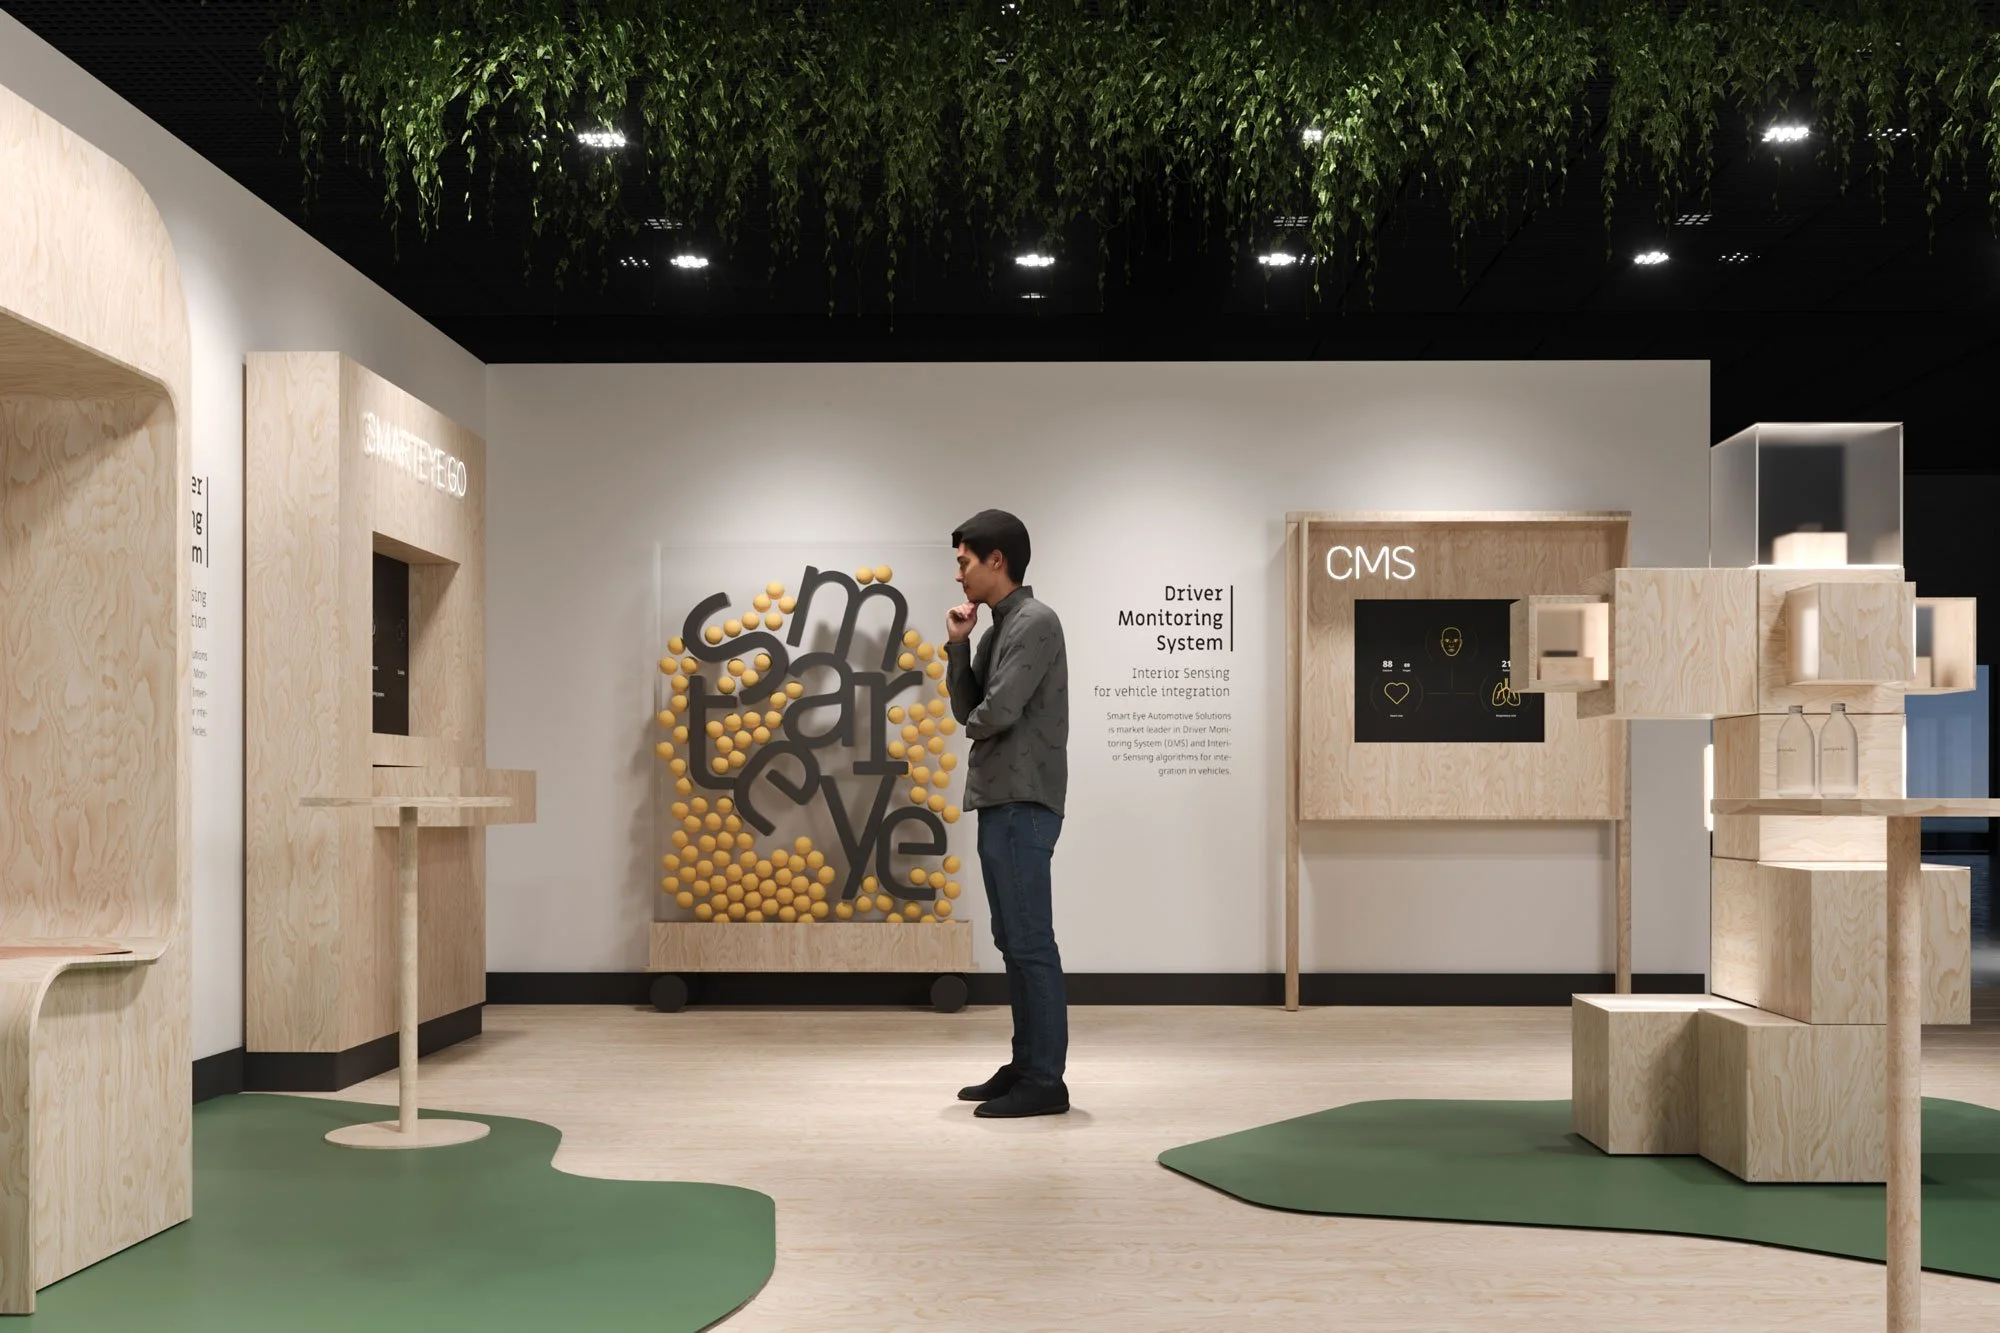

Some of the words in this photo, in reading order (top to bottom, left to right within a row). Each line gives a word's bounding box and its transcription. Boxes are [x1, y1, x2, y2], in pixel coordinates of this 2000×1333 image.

[1325, 545, 1416, 580] CMS
[1164, 584, 1224, 602] Driver
[1118, 609, 1224, 630] Monitoring
[1156, 634, 1224, 655] System
[1382, 660, 1393, 668] 88
[1132, 667, 1180, 679] Interior
[1183, 666, 1230, 682] Sensing
[1094, 685, 1112, 698] for
[1114, 685, 1158, 698] vehicle
[1161, 685, 1230, 700] integration
[1107, 711, 1131, 721] Smart
[1132, 712, 1146, 722] Eye
[1148, 711, 1193, 721] Automotive
[1195, 711, 1232, 721] Solutions
[1108, 725, 1115, 734] is
[1116, 725, 1145, 734] market
[1146, 725, 1171, 734] leader
[1173, 725, 1181, 734] in
[1182, 725, 1207, 734] Driver
[1208, 725, 1232, 734] Moni-
[1107, 739, 1132, 750] toring
[1133, 739, 1162, 750] System
[1163, 738, 1189, 749] (DMS)
[1190, 739, 1206, 748] and
[1207, 739, 1232, 748] Interi-
[1112, 754, 1121, 762] or
[1122, 752, 1154, 764] Sensing
[1155, 752, 1199, 764] algorithms
[1200, 752, 1212, 762] for
[1213, 753, 1232, 762] inte-
[1158, 766, 1188, 778] gration
[1189, 766, 1197, 775] in
[1198, 766, 1232, 776] vehicles.
